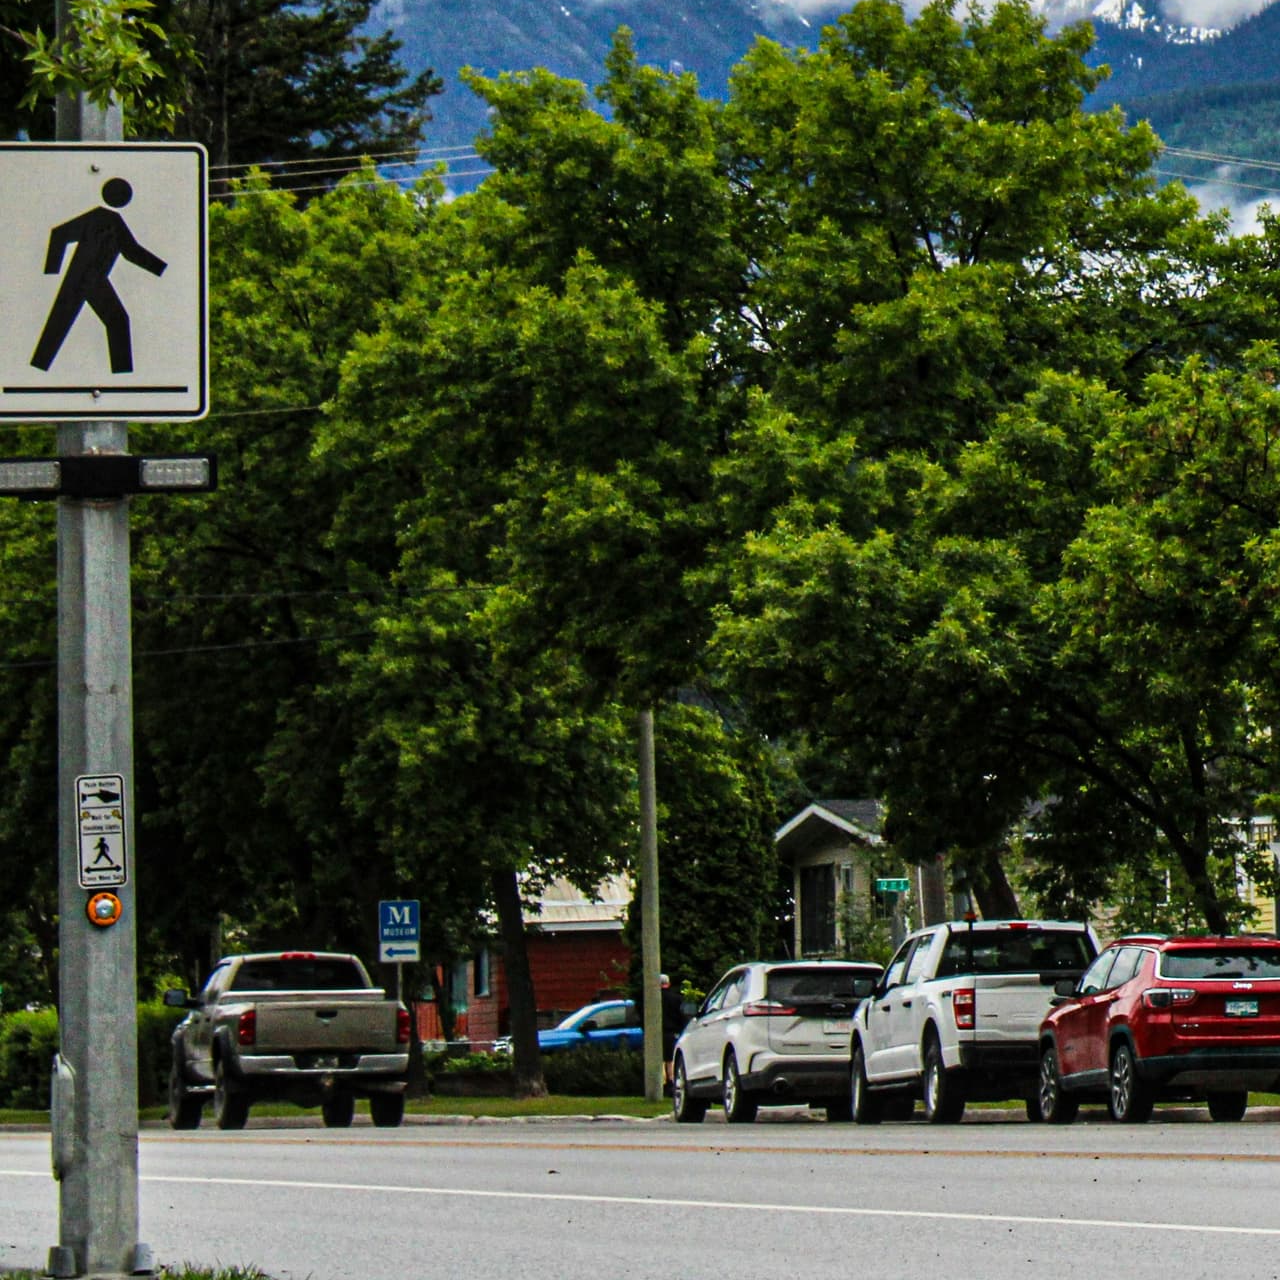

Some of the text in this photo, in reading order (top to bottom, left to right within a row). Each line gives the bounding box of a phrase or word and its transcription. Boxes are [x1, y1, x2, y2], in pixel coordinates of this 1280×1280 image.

[387, 906, 412, 925] M
[384, 928, 416, 936] MUSEUM
[1233, 982, 1252, 990] Jeep
